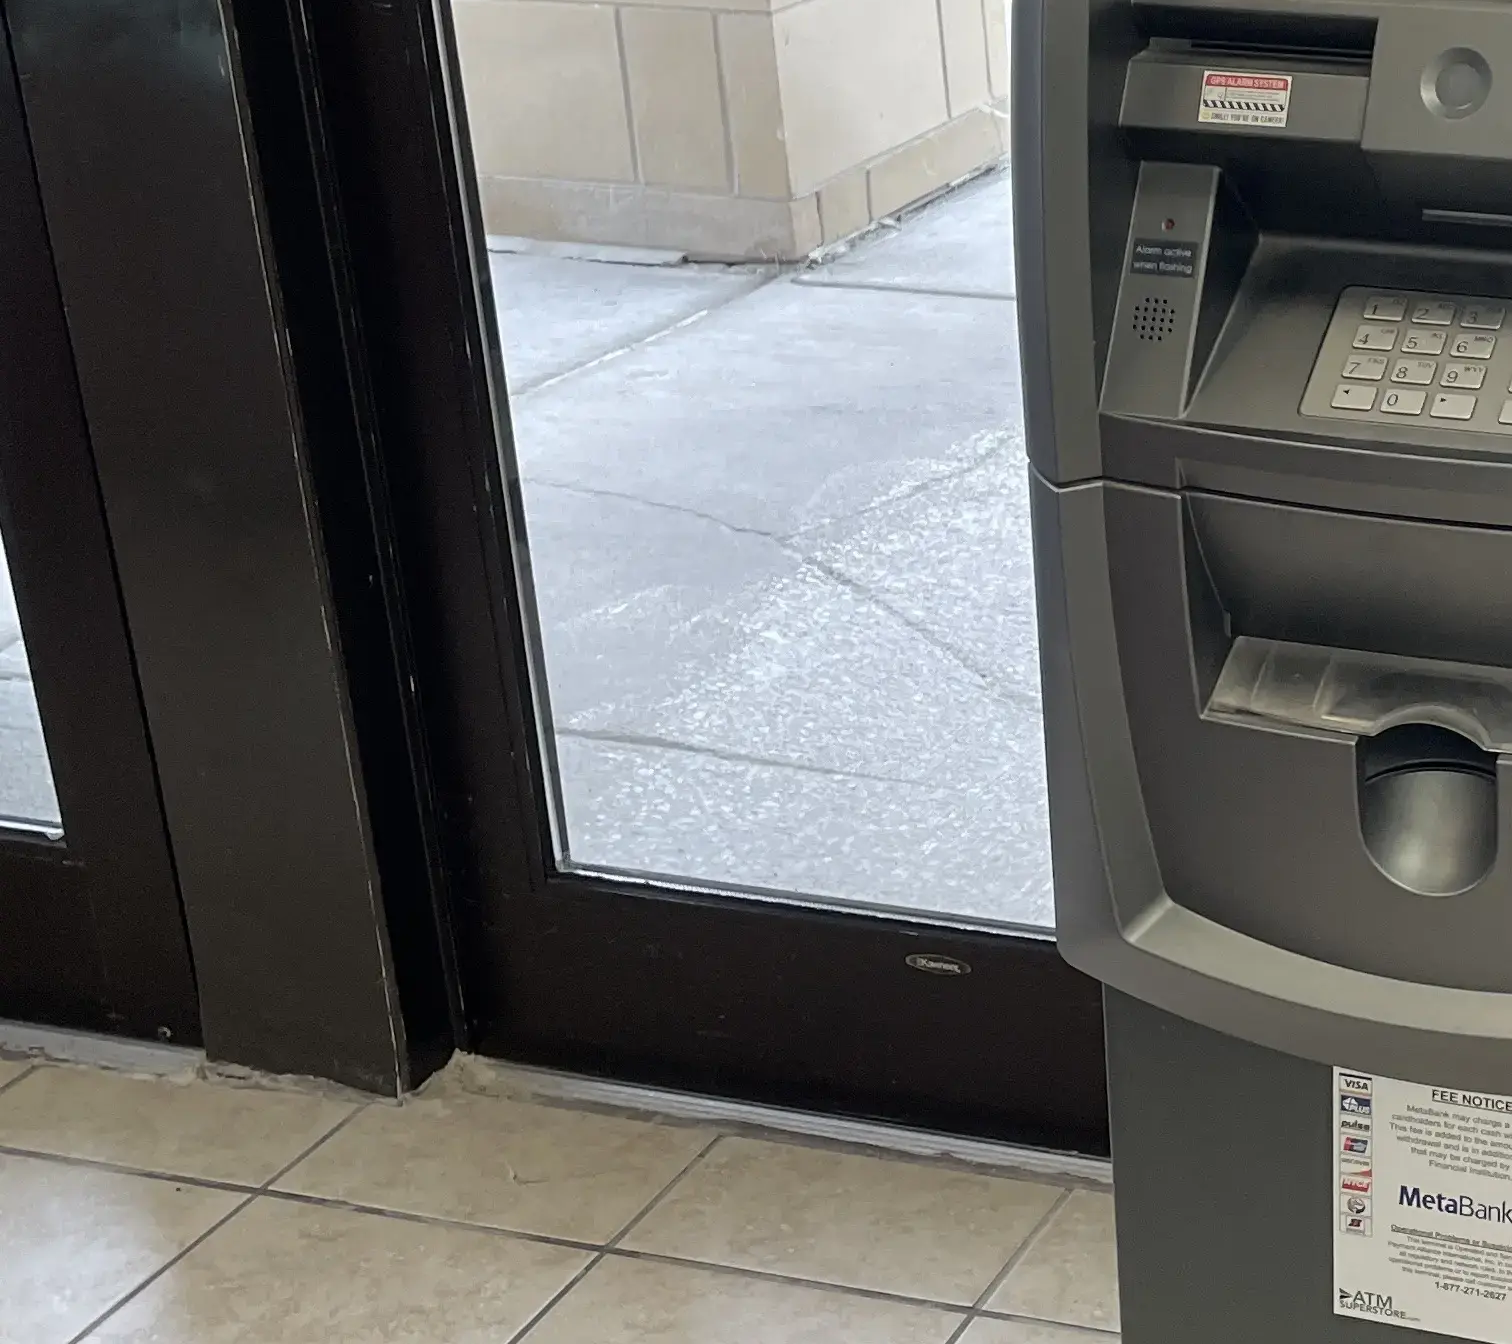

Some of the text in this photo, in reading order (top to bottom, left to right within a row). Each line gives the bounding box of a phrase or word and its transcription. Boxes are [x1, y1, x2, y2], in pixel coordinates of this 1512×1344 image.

[1210, 76, 1284, 89] GPS ALARM SYSTEM
[1136, 244, 1192, 257] Alarm active
[1160, 261, 1193, 274] flashing
[1414, 307, 1429, 321] 2
[1467, 311, 1478, 324] 3
[1358, 332, 1370, 345] 4
[1406, 336, 1419, 349] 5
[1456, 340, 1469, 353] 6
[1348, 361, 1361, 375] 7
[1395, 366, 1409, 379] 8
[1446, 370, 1459, 384] 9
[1386, 393, 1399, 406] 0
[1344, 1078, 1369, 1091] VISA
[1431, 1088, 1459, 1106] FEE
[1353, 1290, 1393, 1310] ATM
